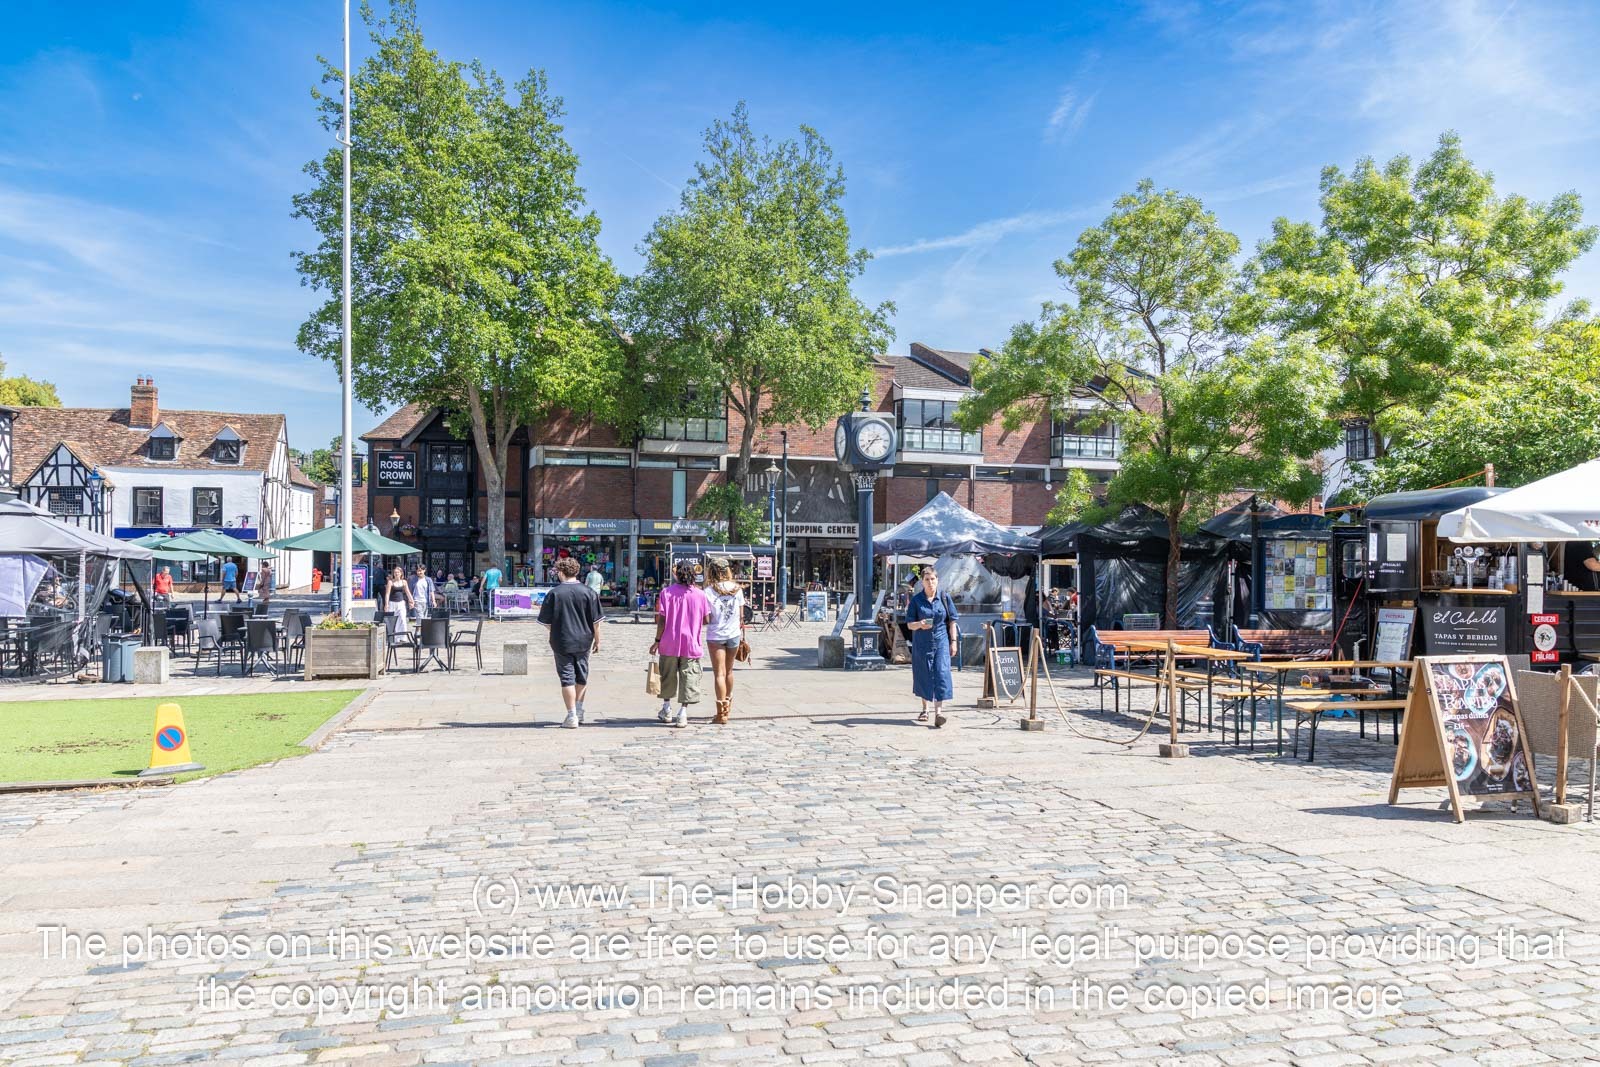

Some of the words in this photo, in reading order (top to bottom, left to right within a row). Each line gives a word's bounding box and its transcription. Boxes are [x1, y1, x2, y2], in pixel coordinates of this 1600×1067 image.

[380, 461, 404, 470] ROSE
[406, 461, 412, 470] &
[380, 471, 412, 480] CROWN
[785, 525, 822, 534] SHOPPING
[827, 525, 857, 534] CENTRE
[1433, 610, 1450, 624] El
[1450, 610, 1497, 625] Caballo
[1437, 674, 1486, 691] TAPAS
